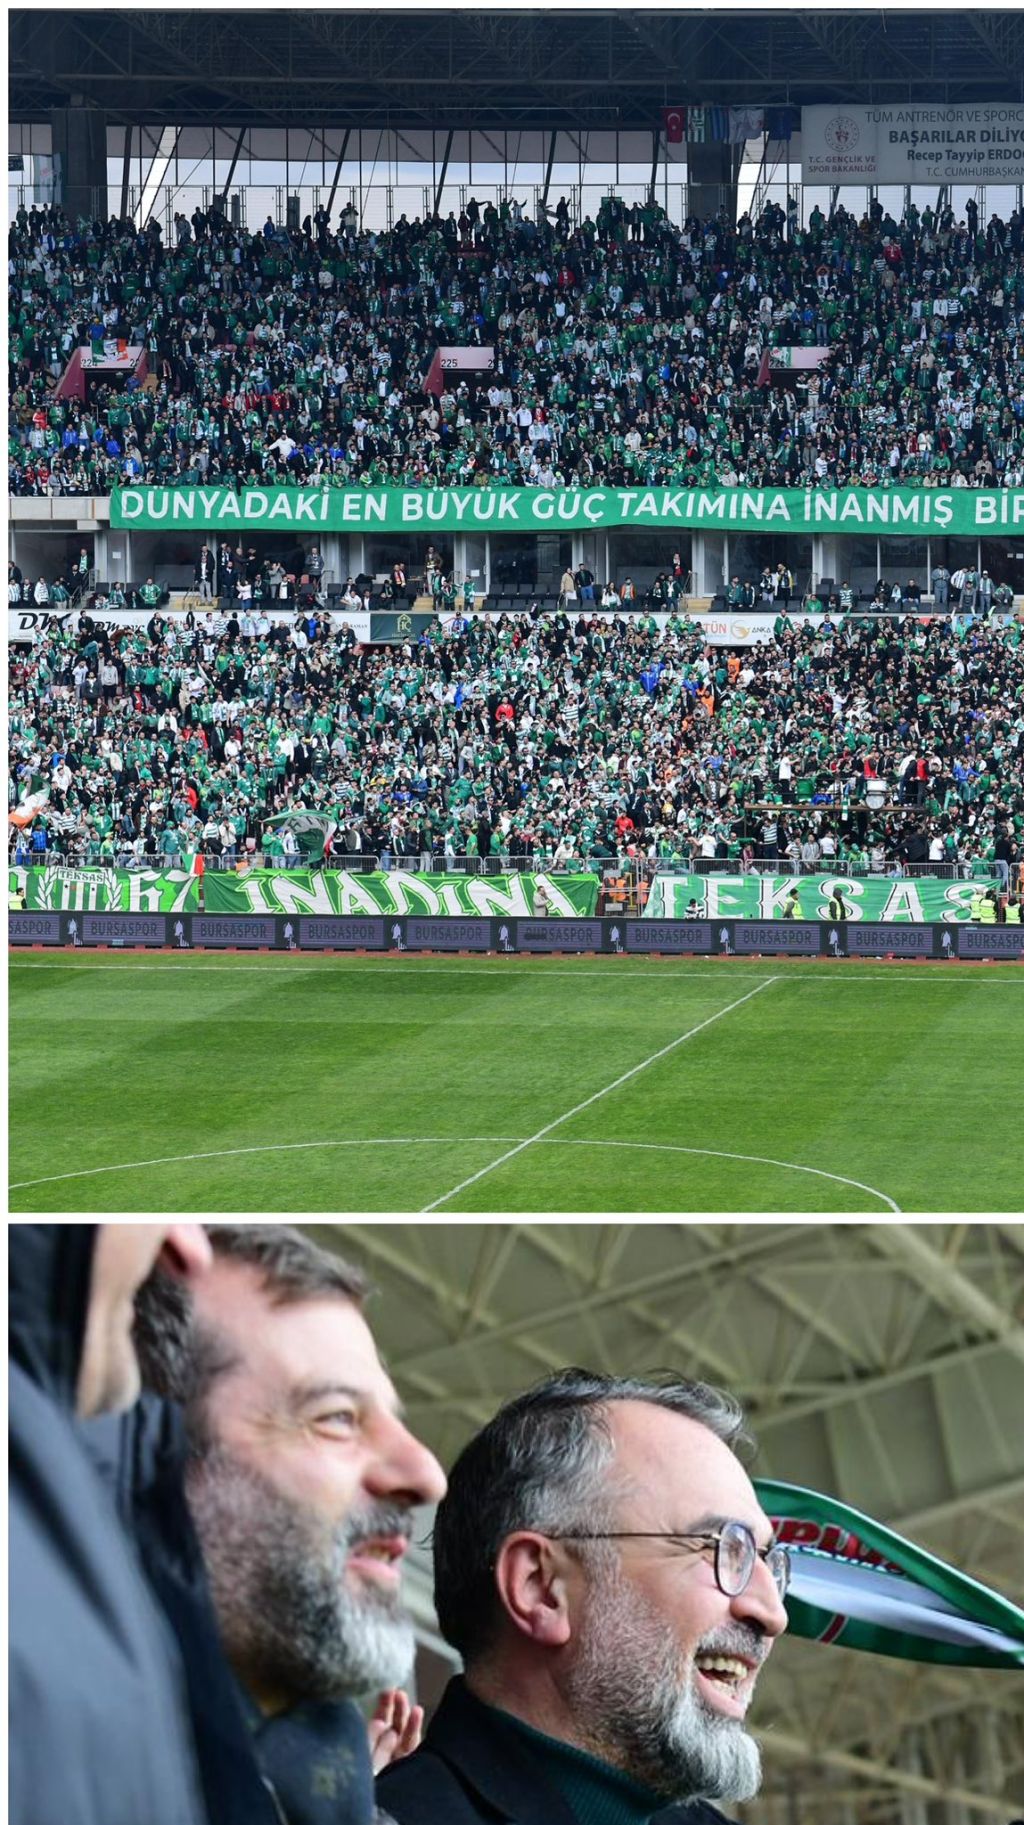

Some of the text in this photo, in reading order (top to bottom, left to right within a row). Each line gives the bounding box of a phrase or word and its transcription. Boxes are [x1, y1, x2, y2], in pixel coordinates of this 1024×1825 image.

[866, 110, 893, 123] TÜM
[897, 108, 963, 123] ANTRENÖR
[967, 110, 981, 122] VE
[888, 130, 977, 146] BAŞARILAR
[808, 154, 876, 165] T.C. GENÇLİK VE
[907, 149, 942, 162] Recep
[945, 149, 984, 163] Tayyip
[808, 163, 876, 173] SPOR BAKANLIĞI
[926, 167, 942, 178] T.C.
[441, 359, 458, 368] 225
[120, 486, 328, 520] DÜNYADAKİ
[343, 493, 388, 521] EN
[402, 486, 520, 521] BÜYÜK
[531, 487, 607, 522] GÜÇ
[617, 492, 791, 521] TAKIMINA
[804, 487, 953, 525] İNANMIŞ
[59, 870, 104, 882] TEKSAS
[659, 876, 996, 922] TEKSAS
[91, 921, 158, 936] BURSASPOR
[201, 922, 267, 938] BURSASPOR
[308, 924, 376, 940] BURSASPOR
[415, 925, 483, 941] BURSASPOR
[634, 926, 703, 943] BURSASPOR
[743, 928, 812, 945] BURSASPOR
[855, 930, 925, 947] BURSASPOR
